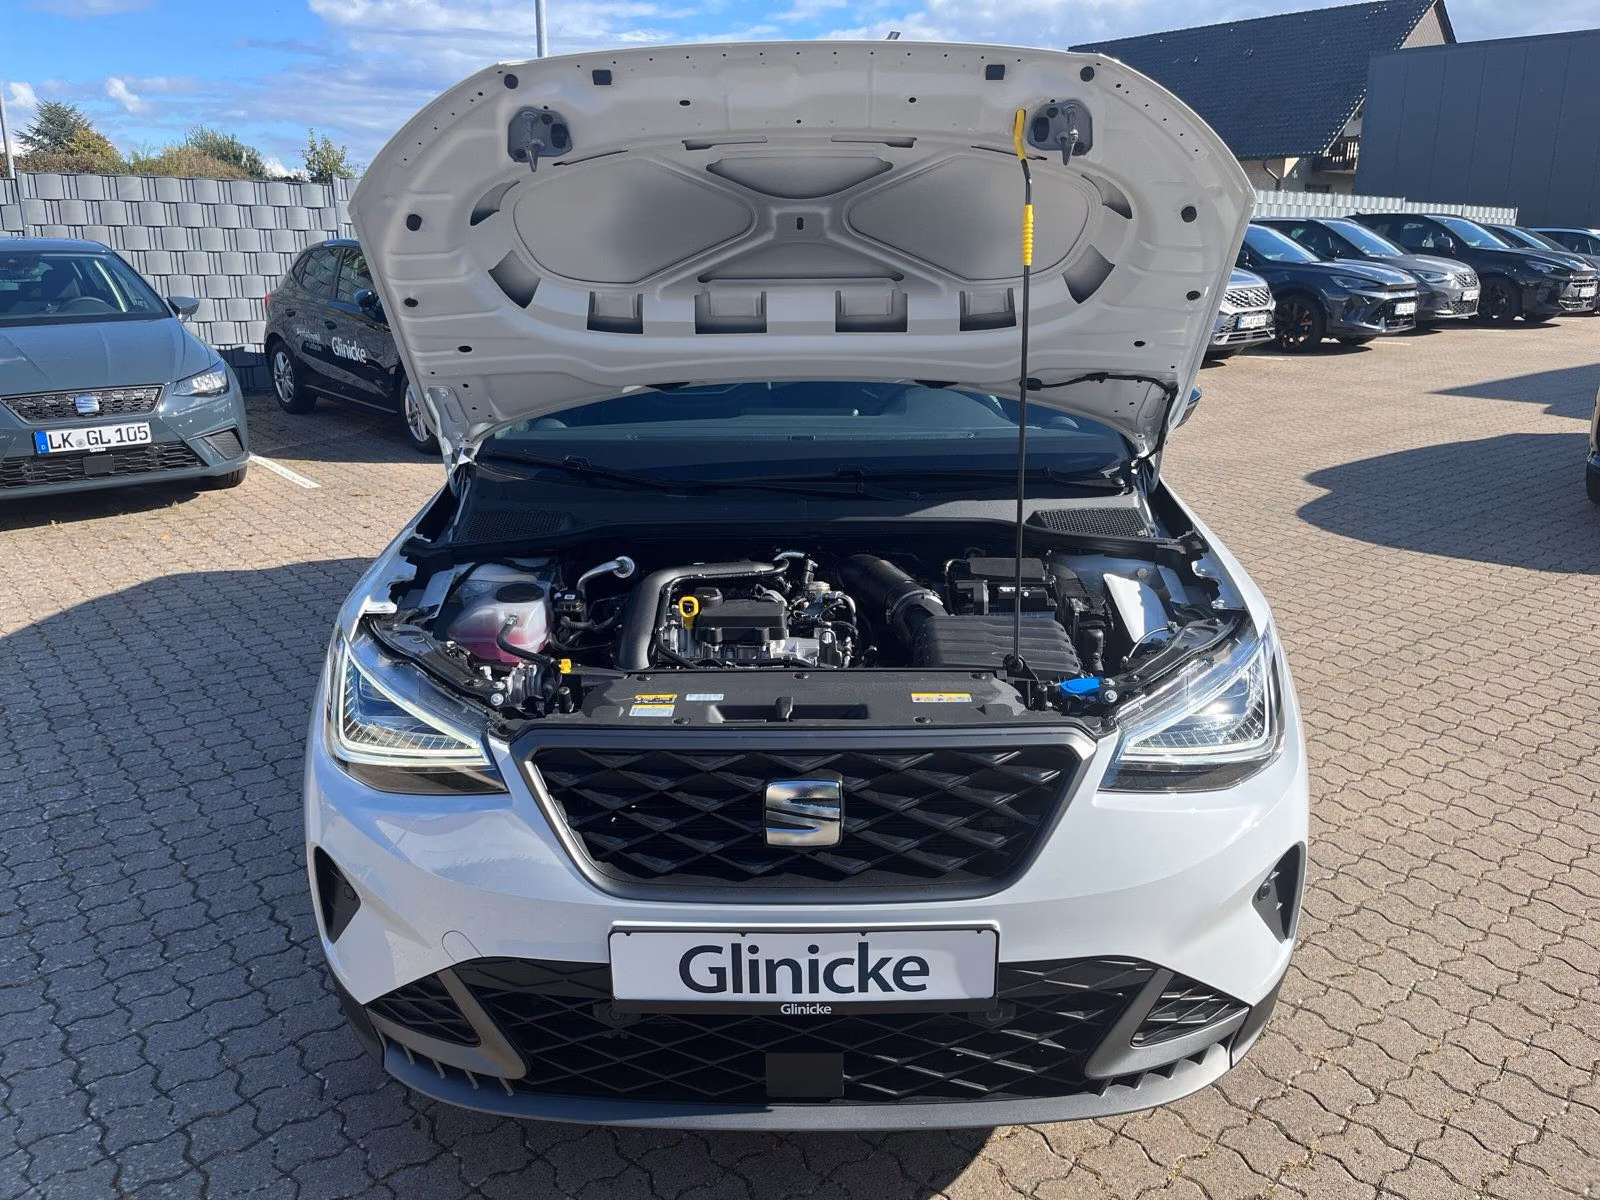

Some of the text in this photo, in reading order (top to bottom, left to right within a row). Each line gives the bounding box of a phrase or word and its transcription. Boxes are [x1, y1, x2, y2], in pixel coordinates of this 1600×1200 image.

[331, 336, 367, 364] Glinicke
[48, 432, 74, 450] LK
[86, 429, 112, 446] GL
[115, 425, 149, 443] 105
[678, 941, 930, 995] Glinicke
[780, 1003, 832, 1016] Glinicke
